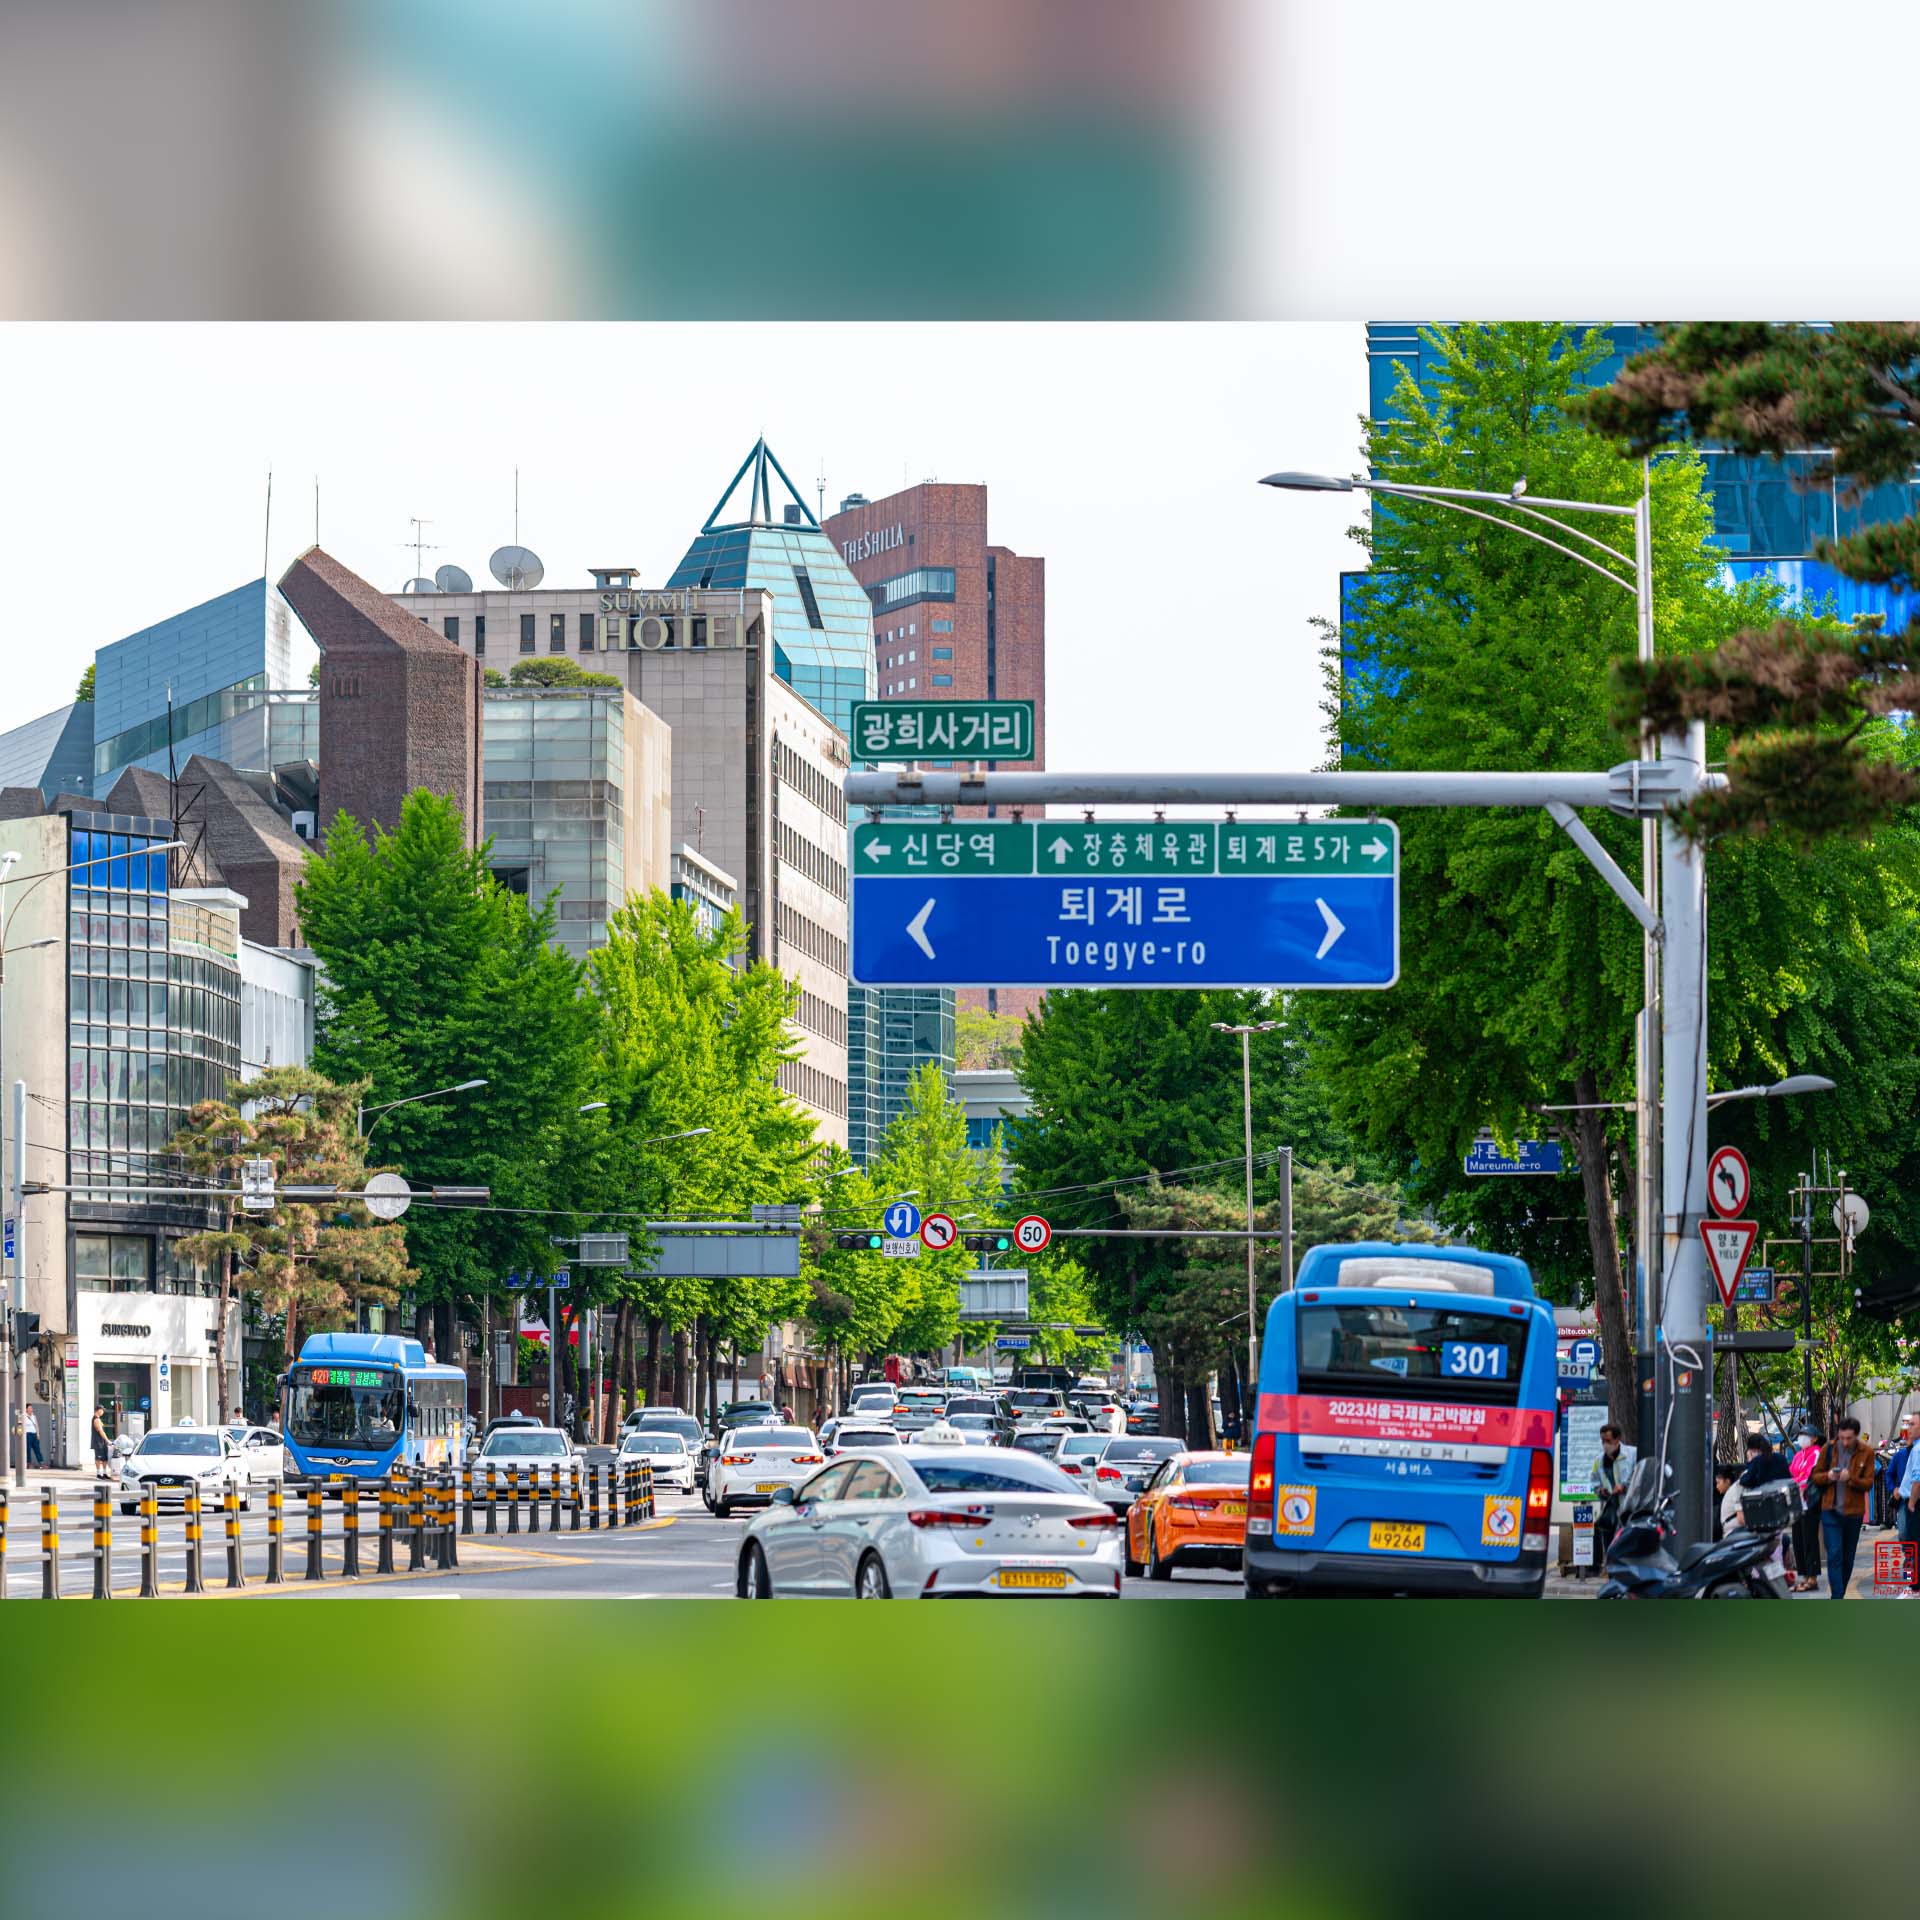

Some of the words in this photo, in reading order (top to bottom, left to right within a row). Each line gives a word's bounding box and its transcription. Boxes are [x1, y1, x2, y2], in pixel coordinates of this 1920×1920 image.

[600, 592, 703, 613] SUMMIT
[599, 616, 757, 652] HOTEL
[862, 711, 1022, 751] 광희사거리
[901, 833, 996, 867] 신당역
[1083, 833, 1208, 866] 장충체육관
[1226, 835, 1352, 865] 퇴계로5가
[1058, 886, 1193, 926] 퇴계로
[1046, 935, 1207, 971] Toegye-ro
[1471, 1143, 1531, 1159] 마른로
[1022, 1226, 1042, 1242] 50
[1718, 1233, 1739, 1248] 양보
[884, 1243, 919, 1255] 보행신호시
[1719, 1249, 1739, 1260] YIELD
[1450, 1345, 1500, 1376] 301
[311, 1369, 329, 1385] 420
[1562, 1364, 1585, 1376] 301
[1384, 1461, 1433, 1476] 서울버스
[1577, 1512, 1593, 1523] 229
